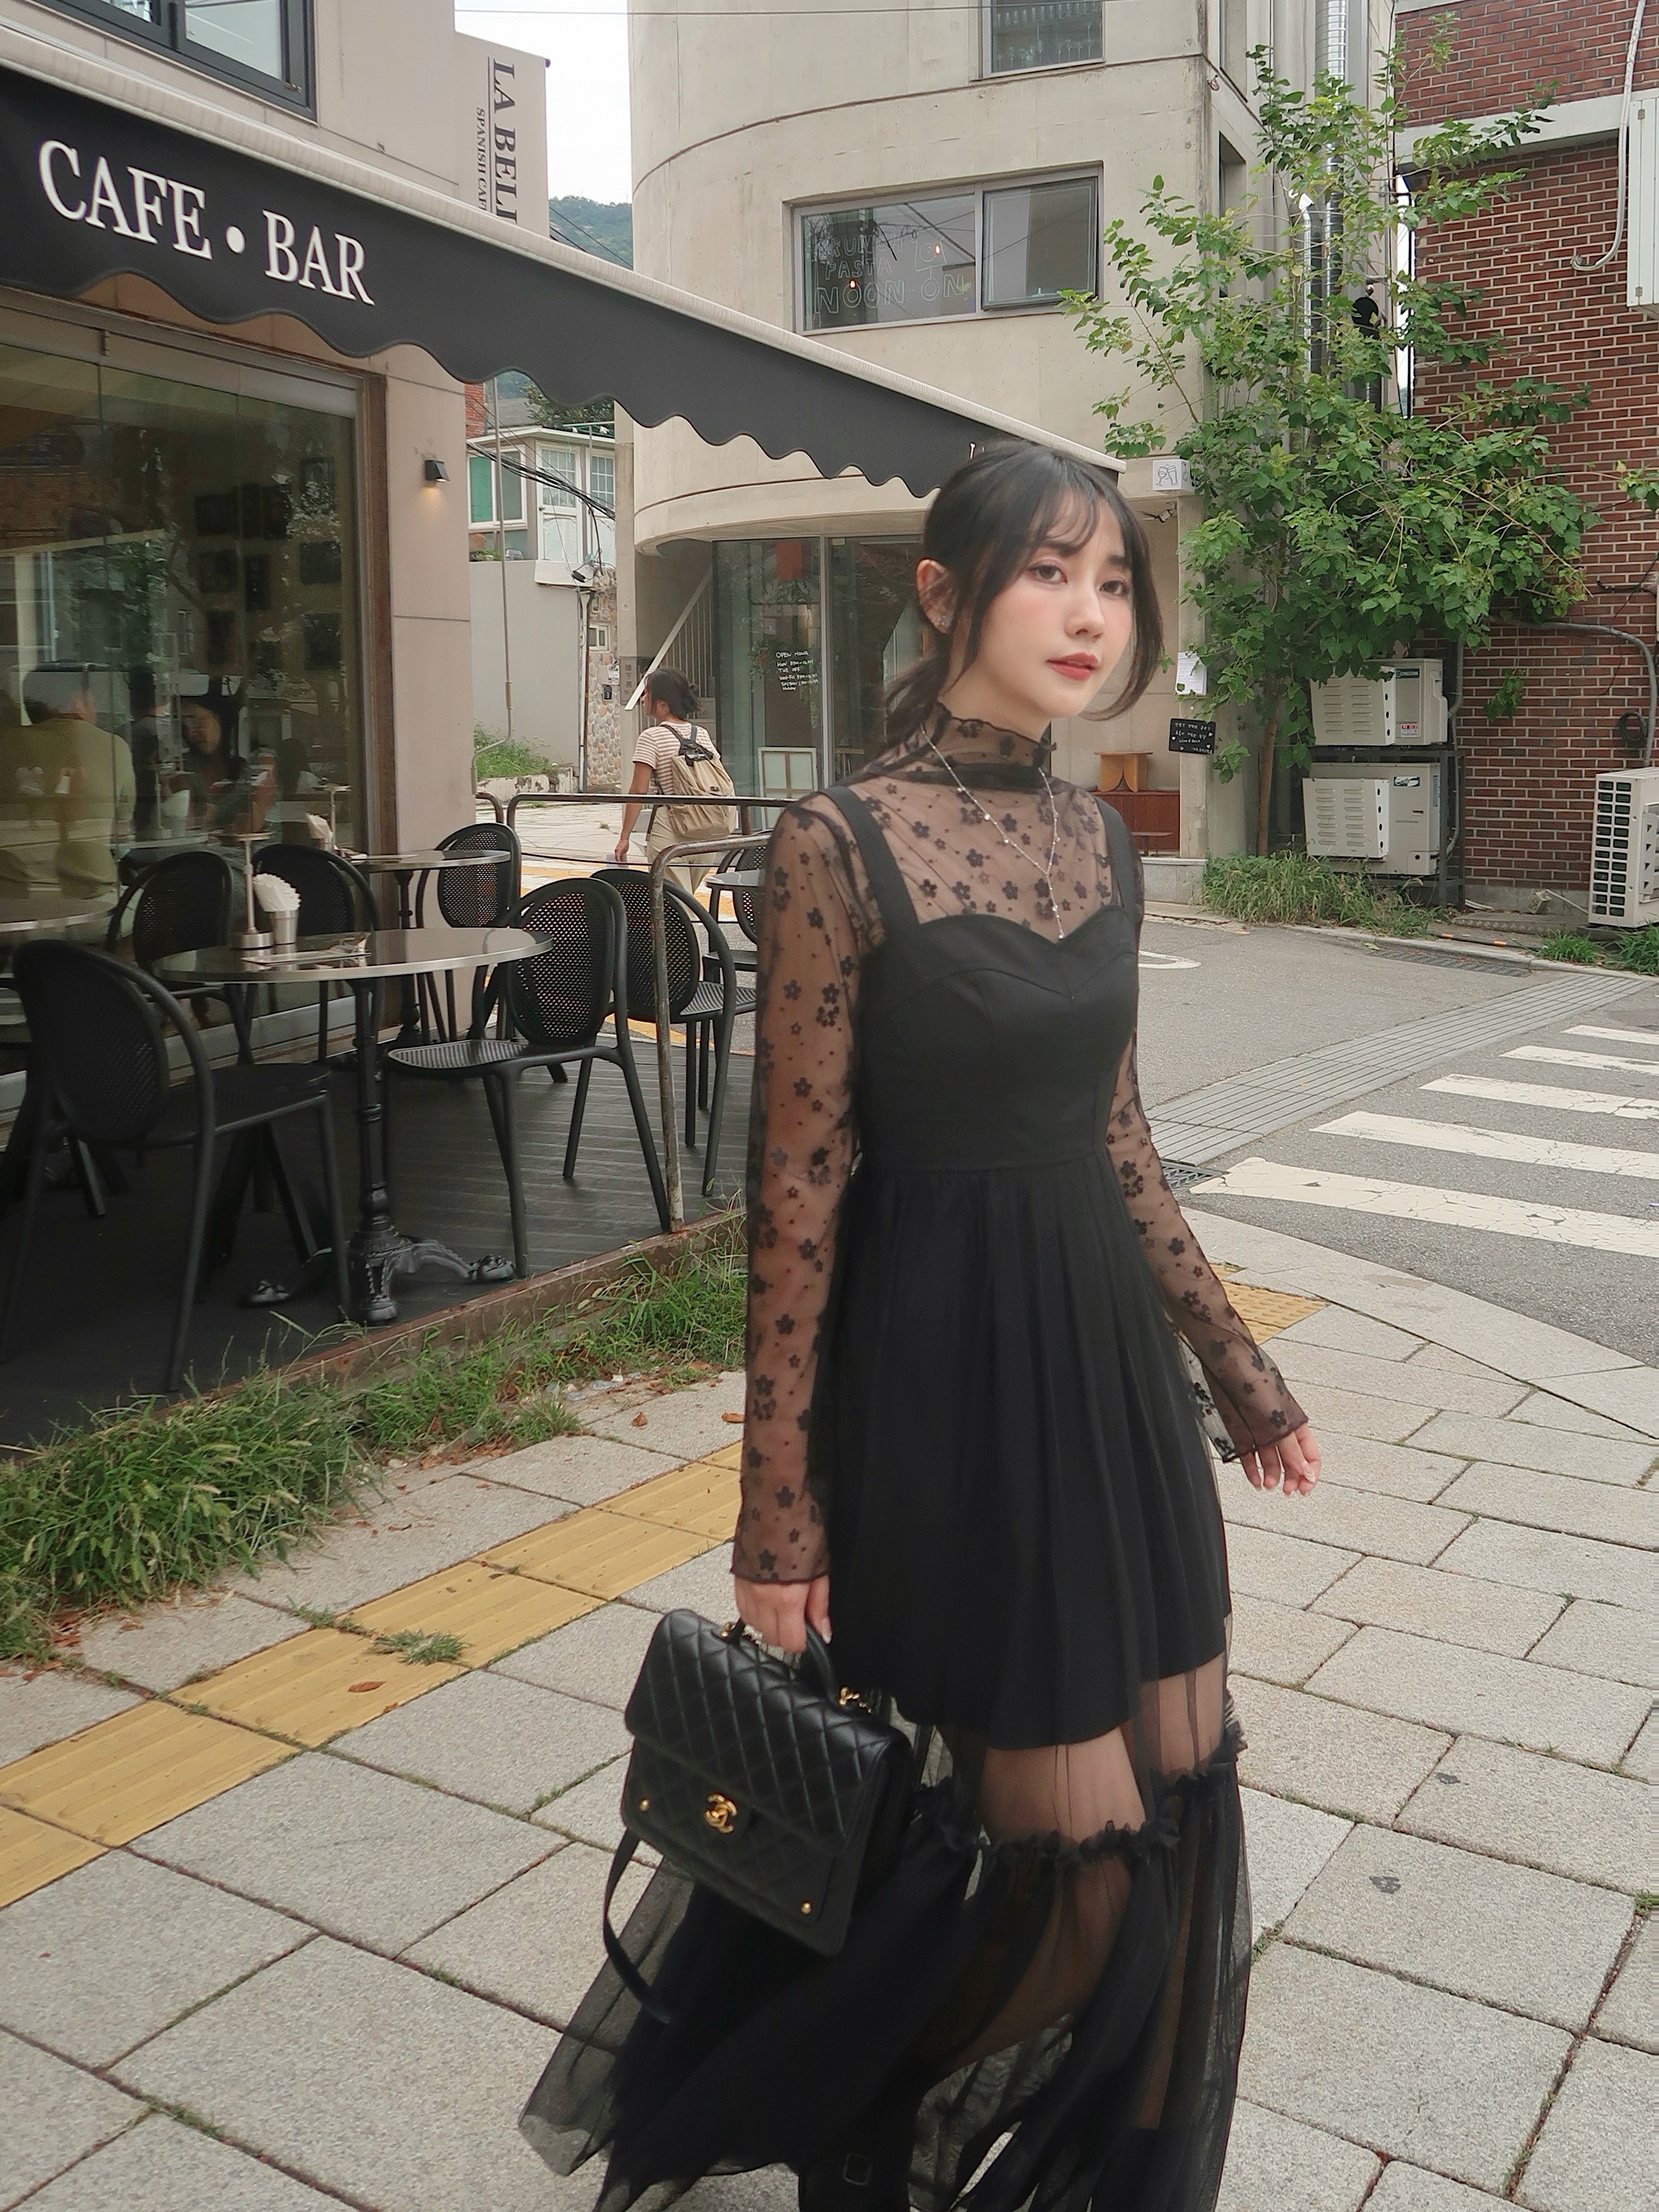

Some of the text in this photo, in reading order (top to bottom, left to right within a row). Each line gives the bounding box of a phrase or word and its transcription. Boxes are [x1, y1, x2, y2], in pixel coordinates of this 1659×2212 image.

[493, 57, 516, 114] LA
[476, 106, 487, 174] SPANISH
[39, 139, 375, 306] CAFE BAR
[814, 274, 964, 313] NOON ON
[825, 258, 893, 281] PASTA
